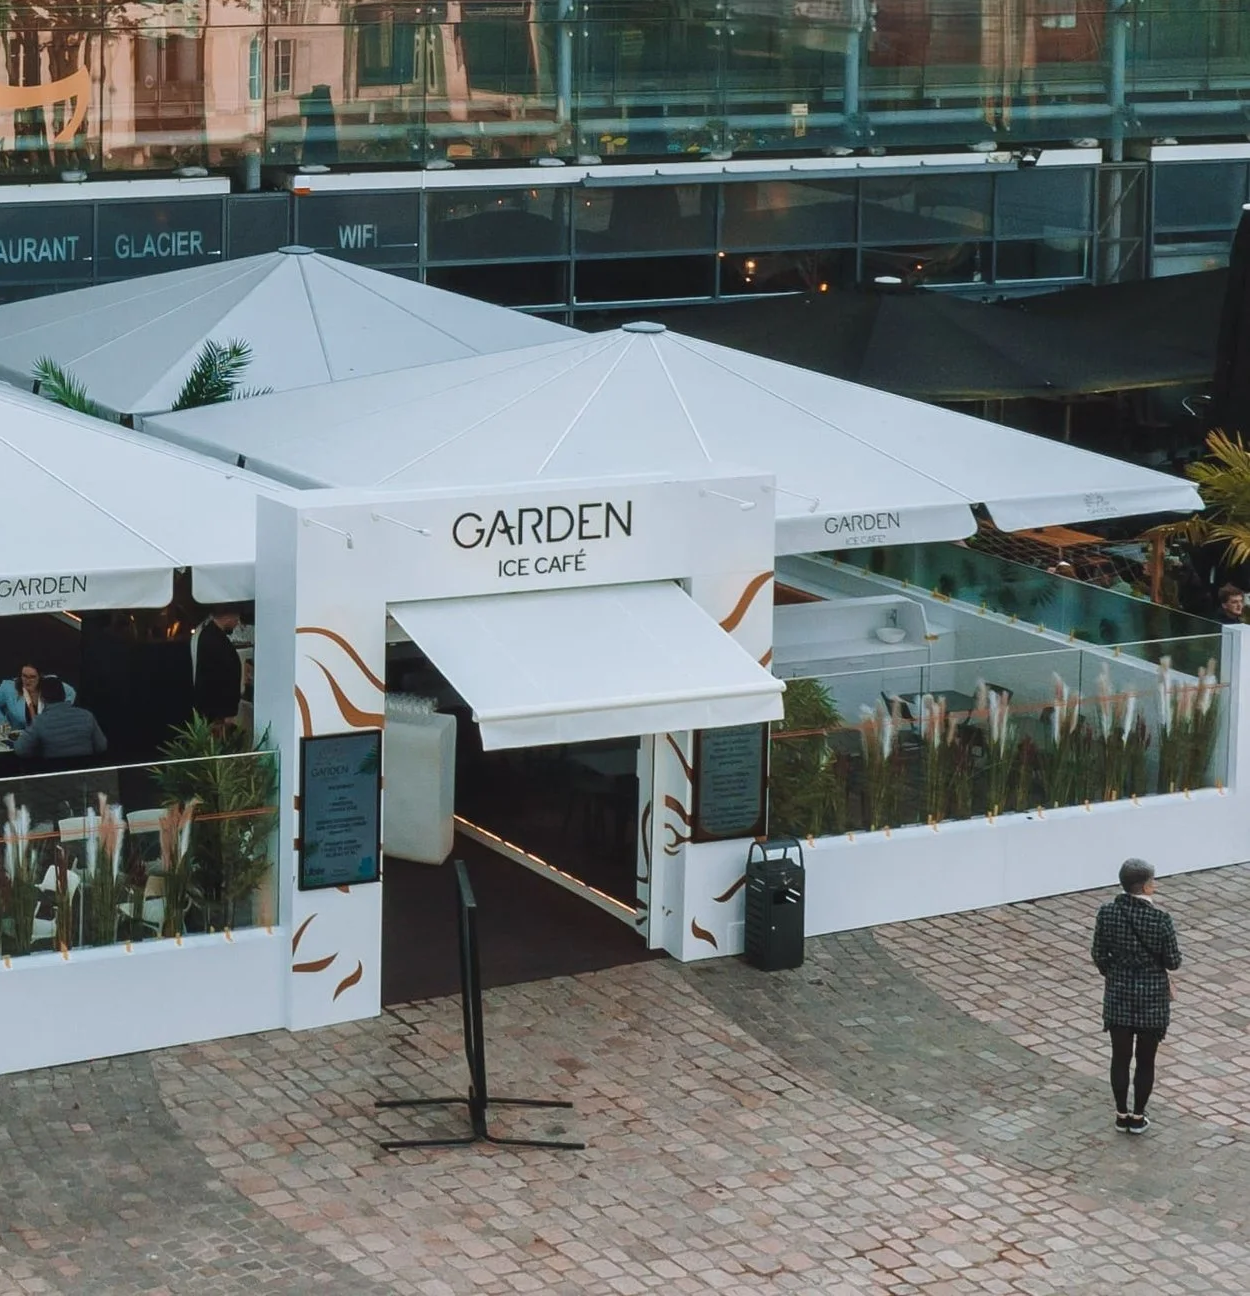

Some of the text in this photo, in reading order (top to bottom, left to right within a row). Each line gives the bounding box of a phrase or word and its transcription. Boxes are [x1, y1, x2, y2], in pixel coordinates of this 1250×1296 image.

[114, 230, 204, 260] GLACIER
[338, 223, 378, 249] WIFI
[452, 500, 632, 549] GARDEN
[824, 511, 901, 534] GARDEN
[498, 548, 587, 578] ICE CAFÉ
[18, 601, 35, 611] ICE
